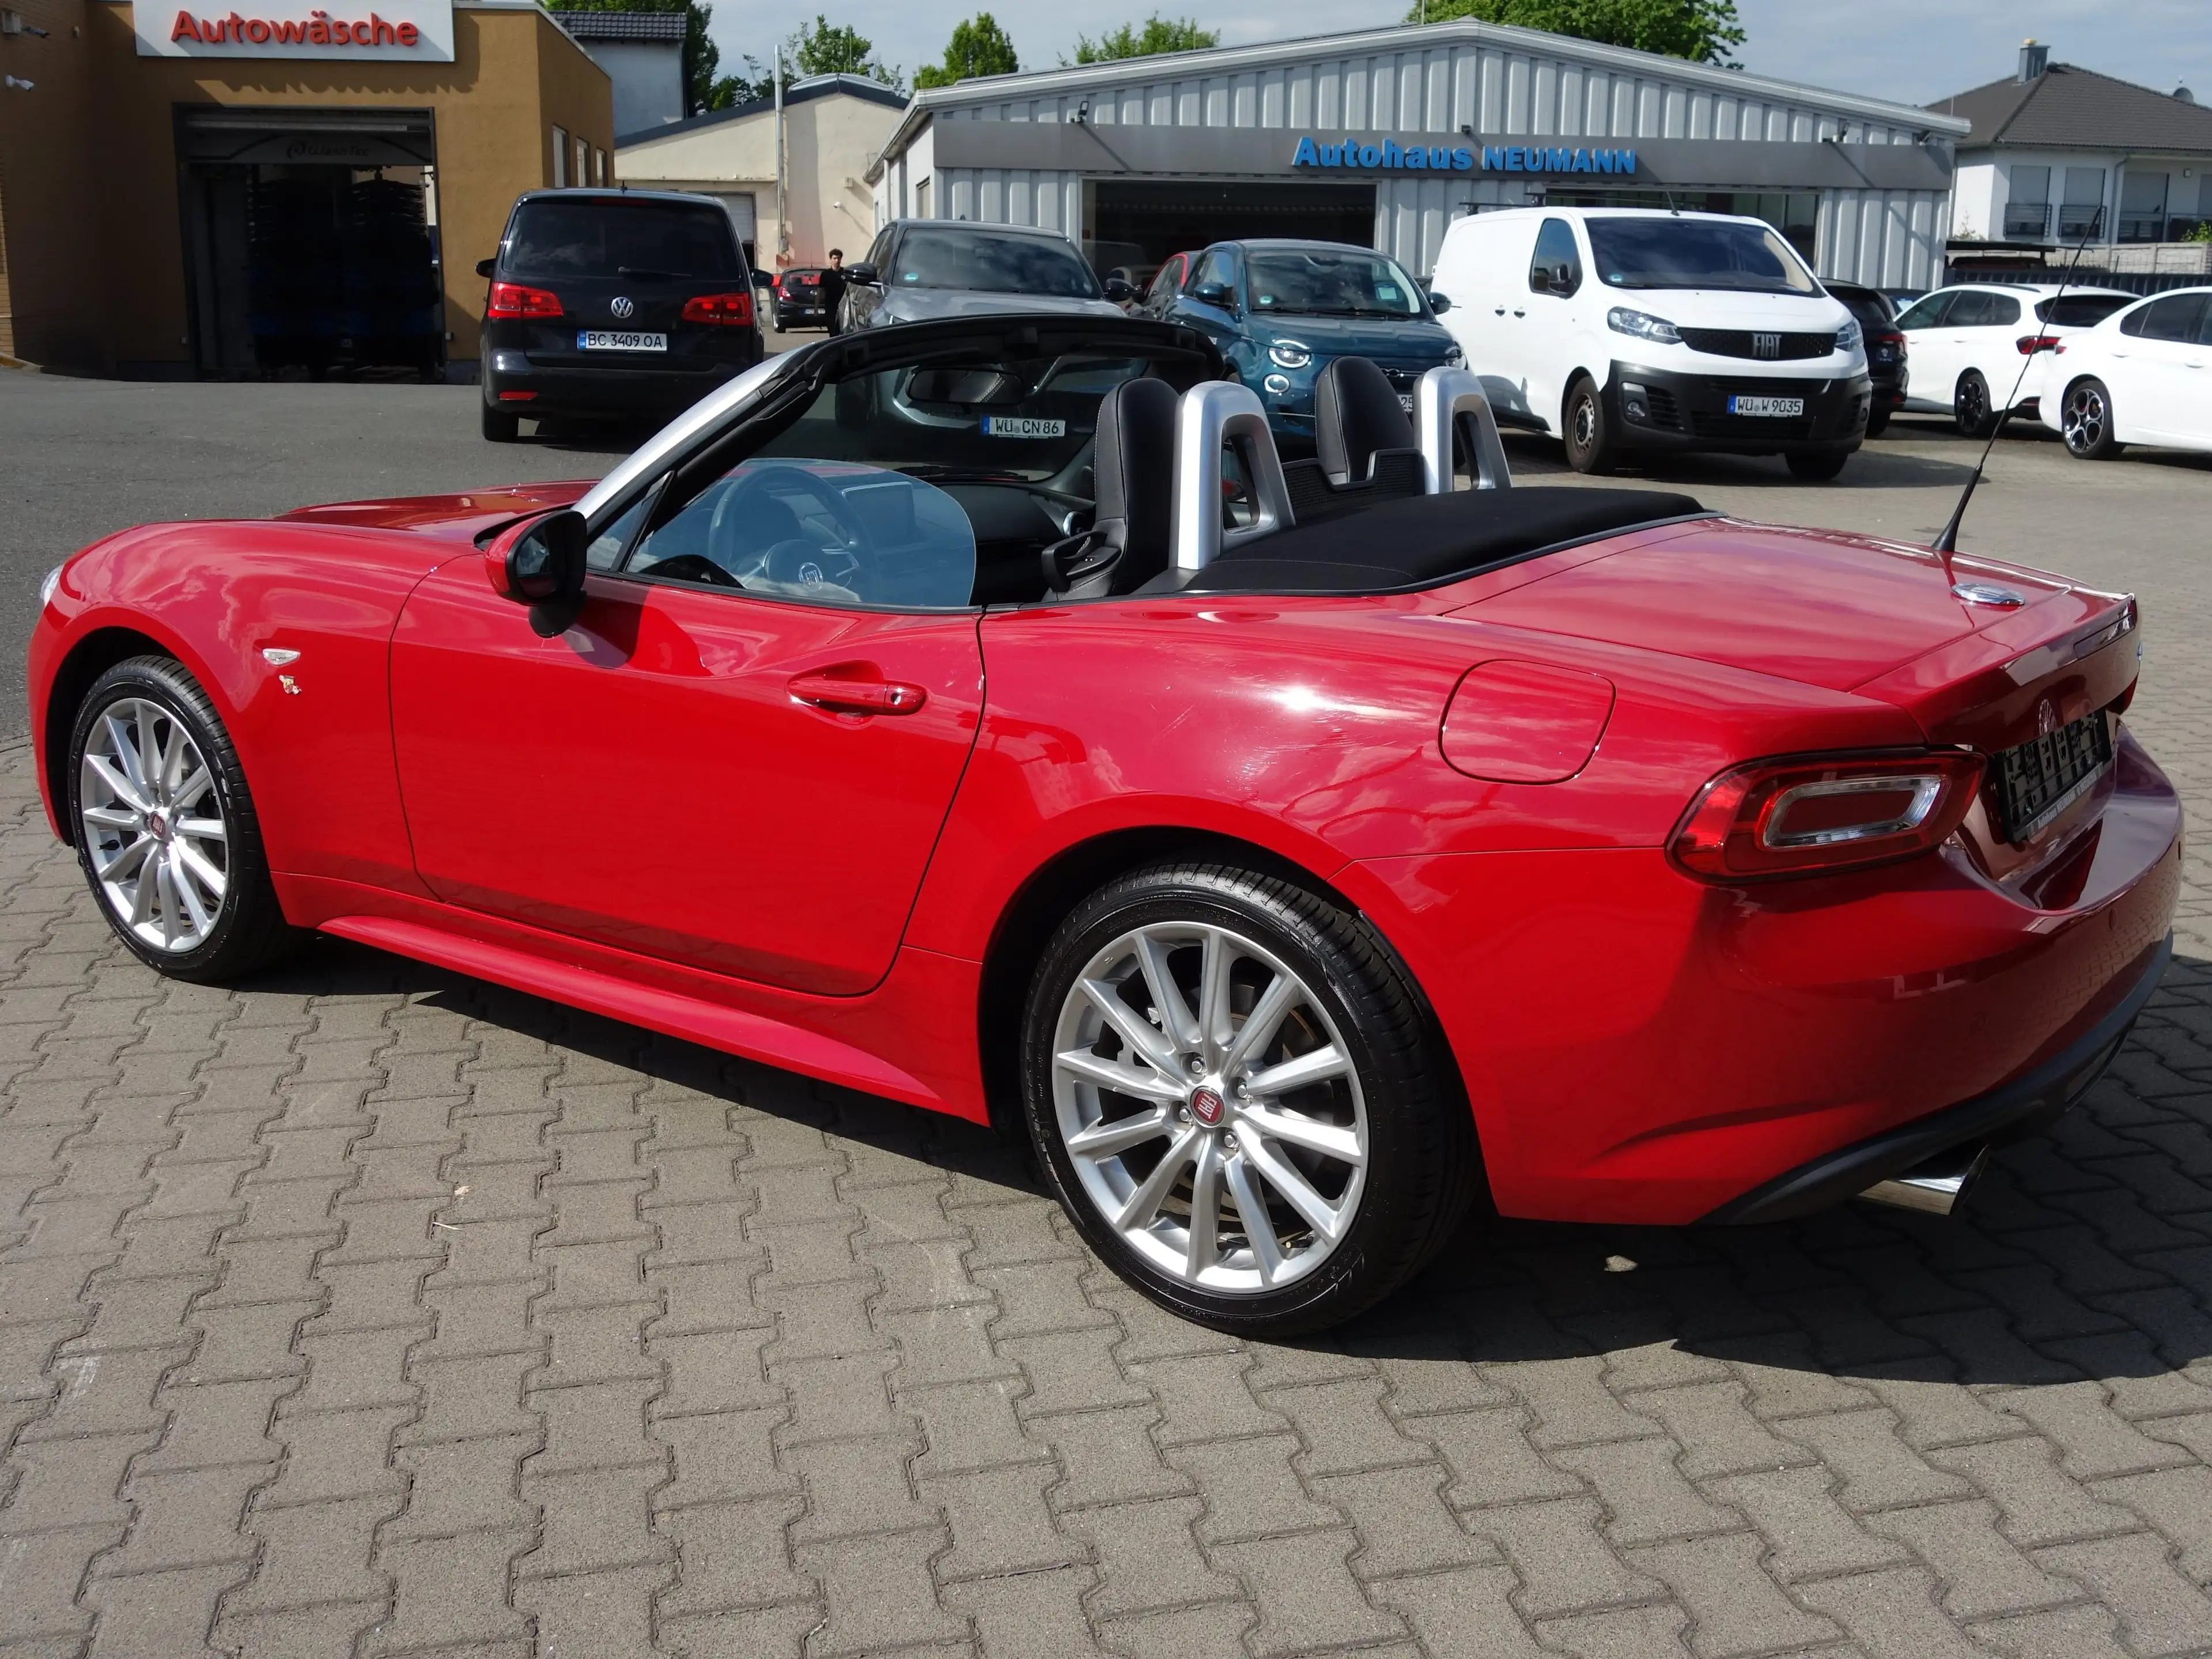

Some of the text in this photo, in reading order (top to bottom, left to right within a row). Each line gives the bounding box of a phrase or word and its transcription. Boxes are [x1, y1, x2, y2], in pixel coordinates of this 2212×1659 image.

[171, 10, 418, 46] Autowäsche
[1291, 137, 1636, 173] Autohaus NEUMANN
[588, 334, 606, 346] BC
[610, 334, 640, 347] 3409
[644, 335, 662, 348] OA
[1752, 333, 1782, 358] FIAT
[1738, 398, 1753, 411] WÜ
[1762, 399, 1769, 411] W
[1772, 400, 1802, 412] 9035
[995, 418, 1013, 433] WÜ
[1022, 420, 1039, 434] CN
[1043, 422, 1058, 434] 86
[1197, 1093, 1217, 1119] FIAT
